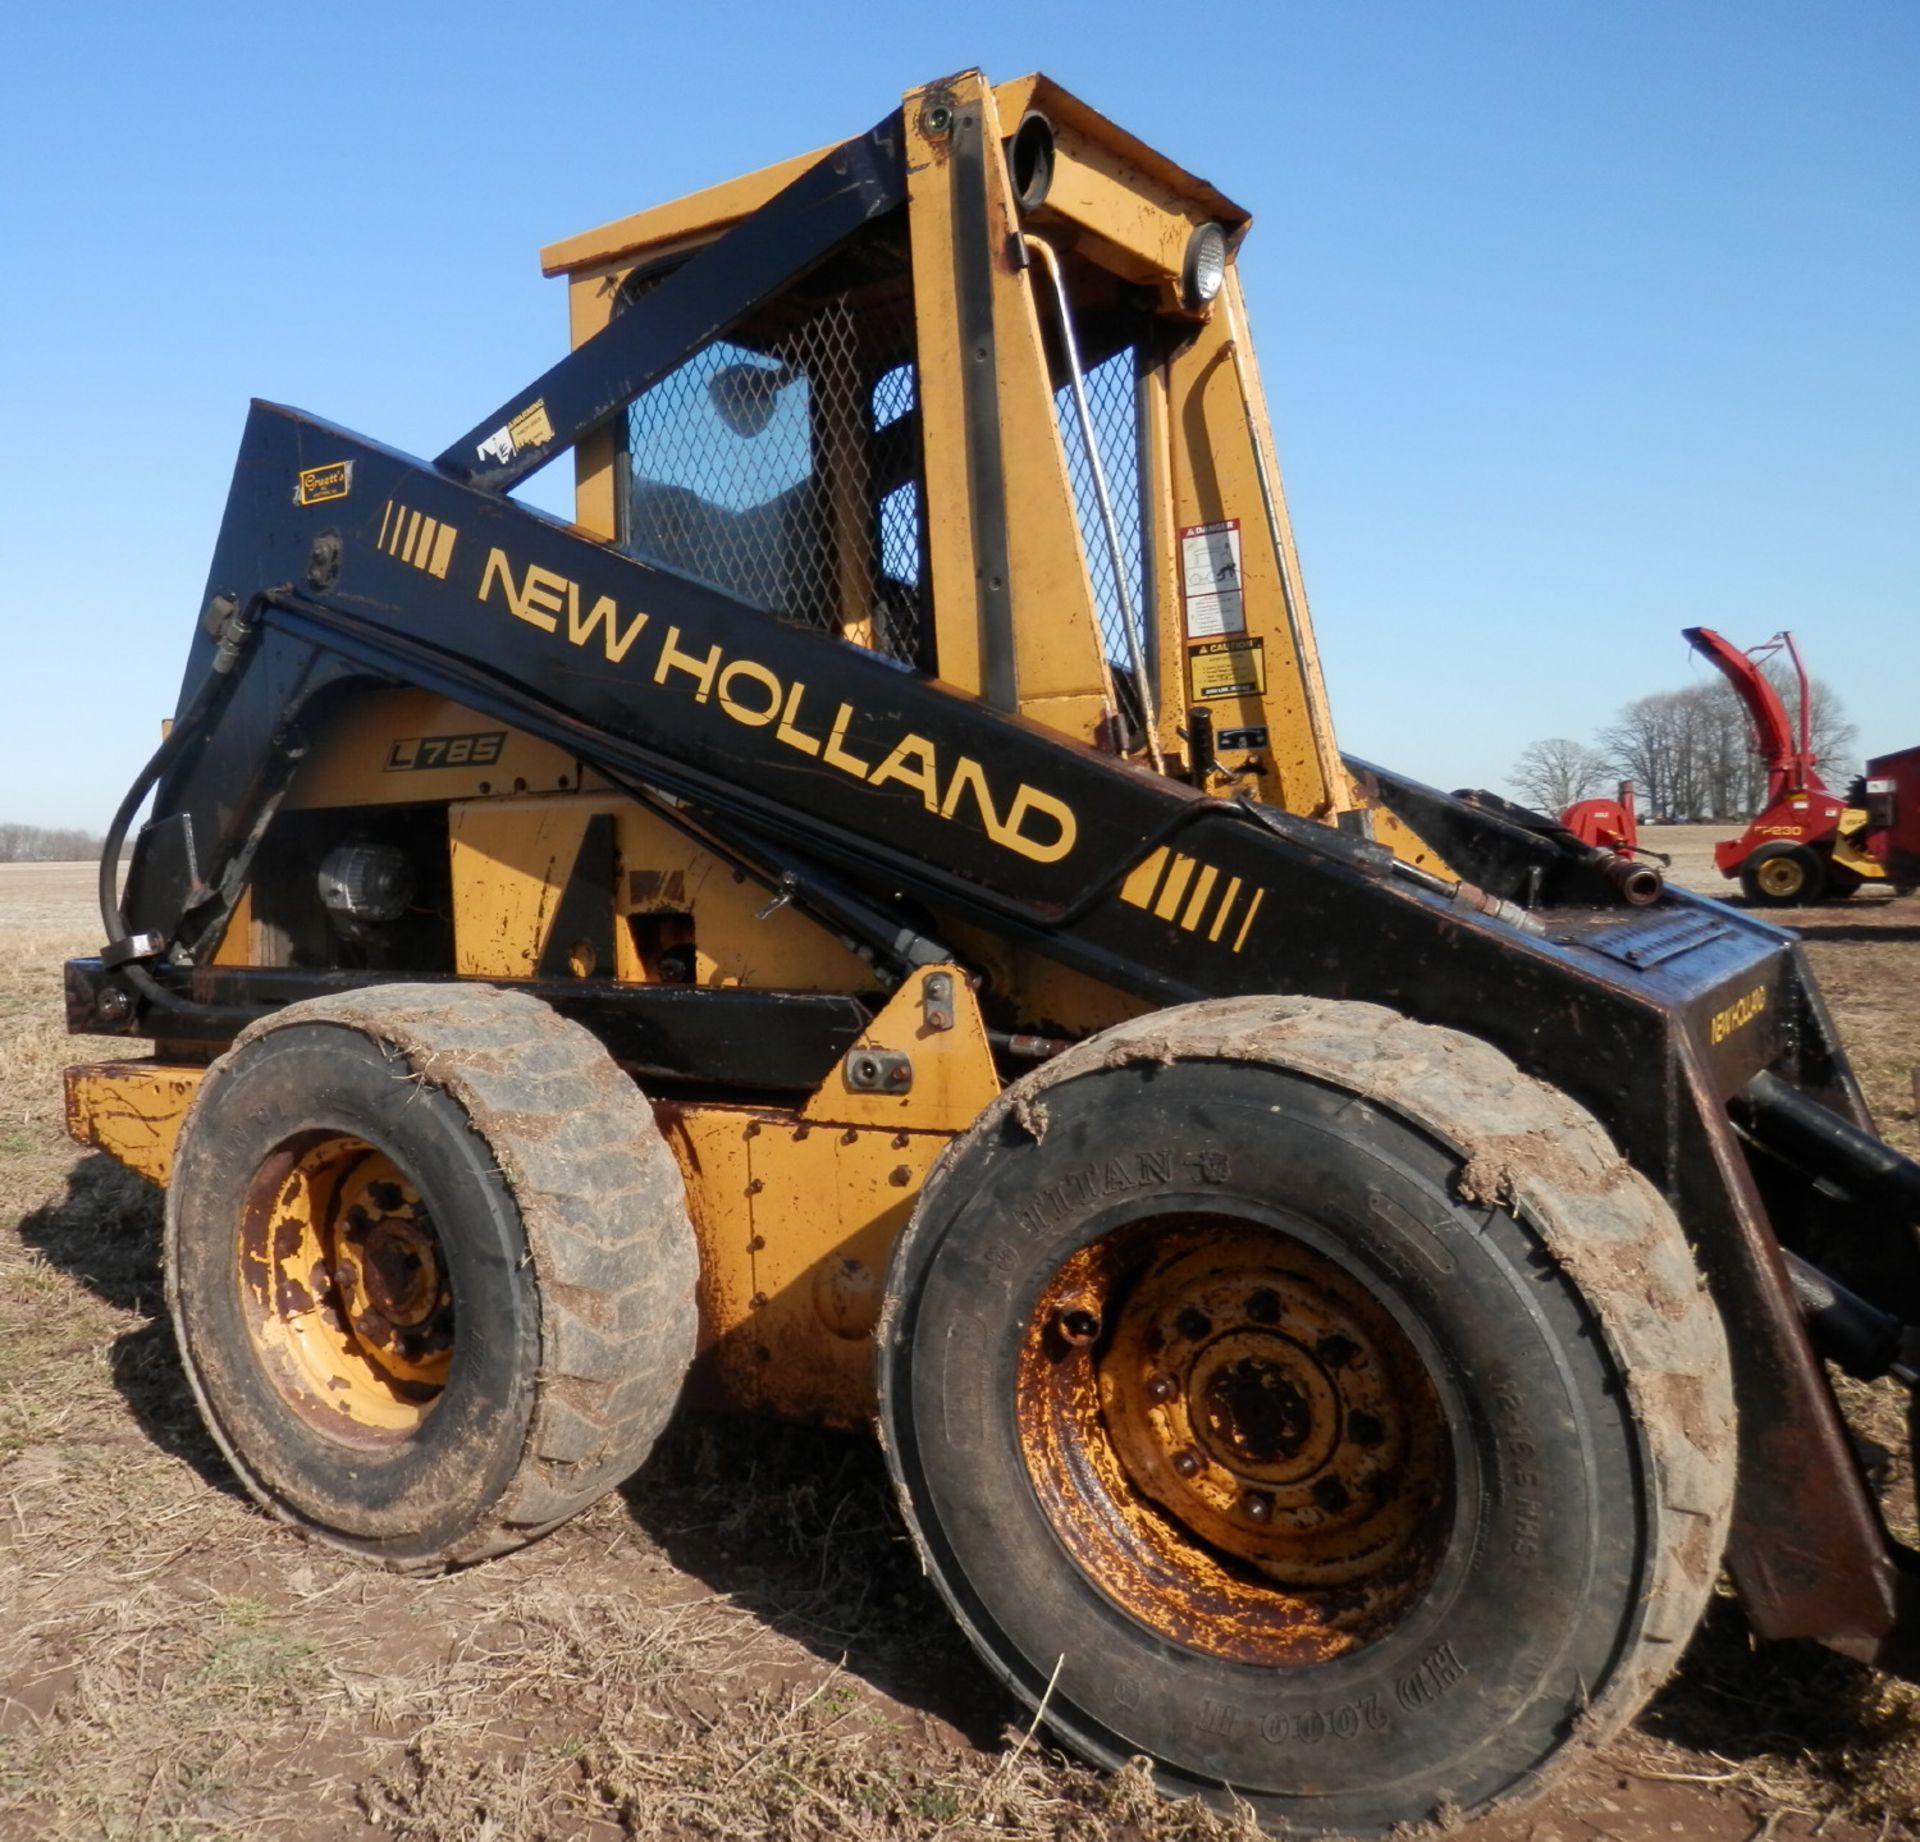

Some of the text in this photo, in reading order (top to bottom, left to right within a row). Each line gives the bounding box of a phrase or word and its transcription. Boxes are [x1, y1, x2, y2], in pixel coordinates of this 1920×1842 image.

[477, 547, 1077, 863] NEW HOLLAND
[1013, 1148, 1175, 1241] TITAN
[1257, 1692, 1390, 1744] 2000
[1398, 1640, 1469, 1714] HD
